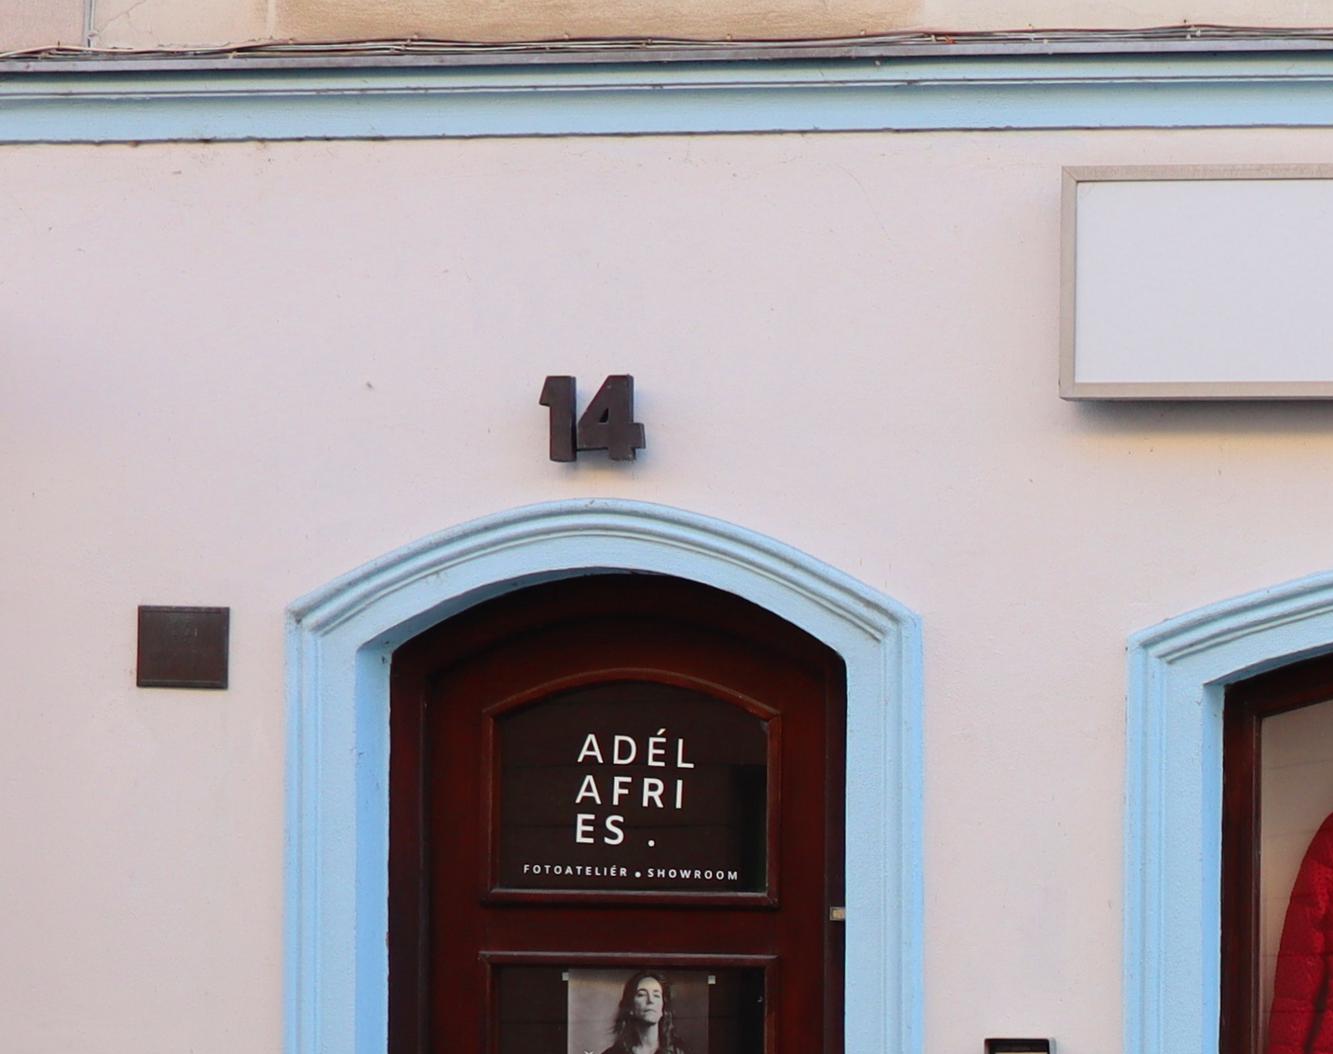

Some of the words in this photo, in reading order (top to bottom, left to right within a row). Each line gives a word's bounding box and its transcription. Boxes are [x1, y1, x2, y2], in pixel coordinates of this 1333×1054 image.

[539, 374, 646, 462] 14
[576, 727, 695, 769] ADÉL
[574, 774, 684, 809] AFRI
[523, 864, 628, 877] FOTOATELIÉR
[647, 868, 738, 881] SHOWROOM
